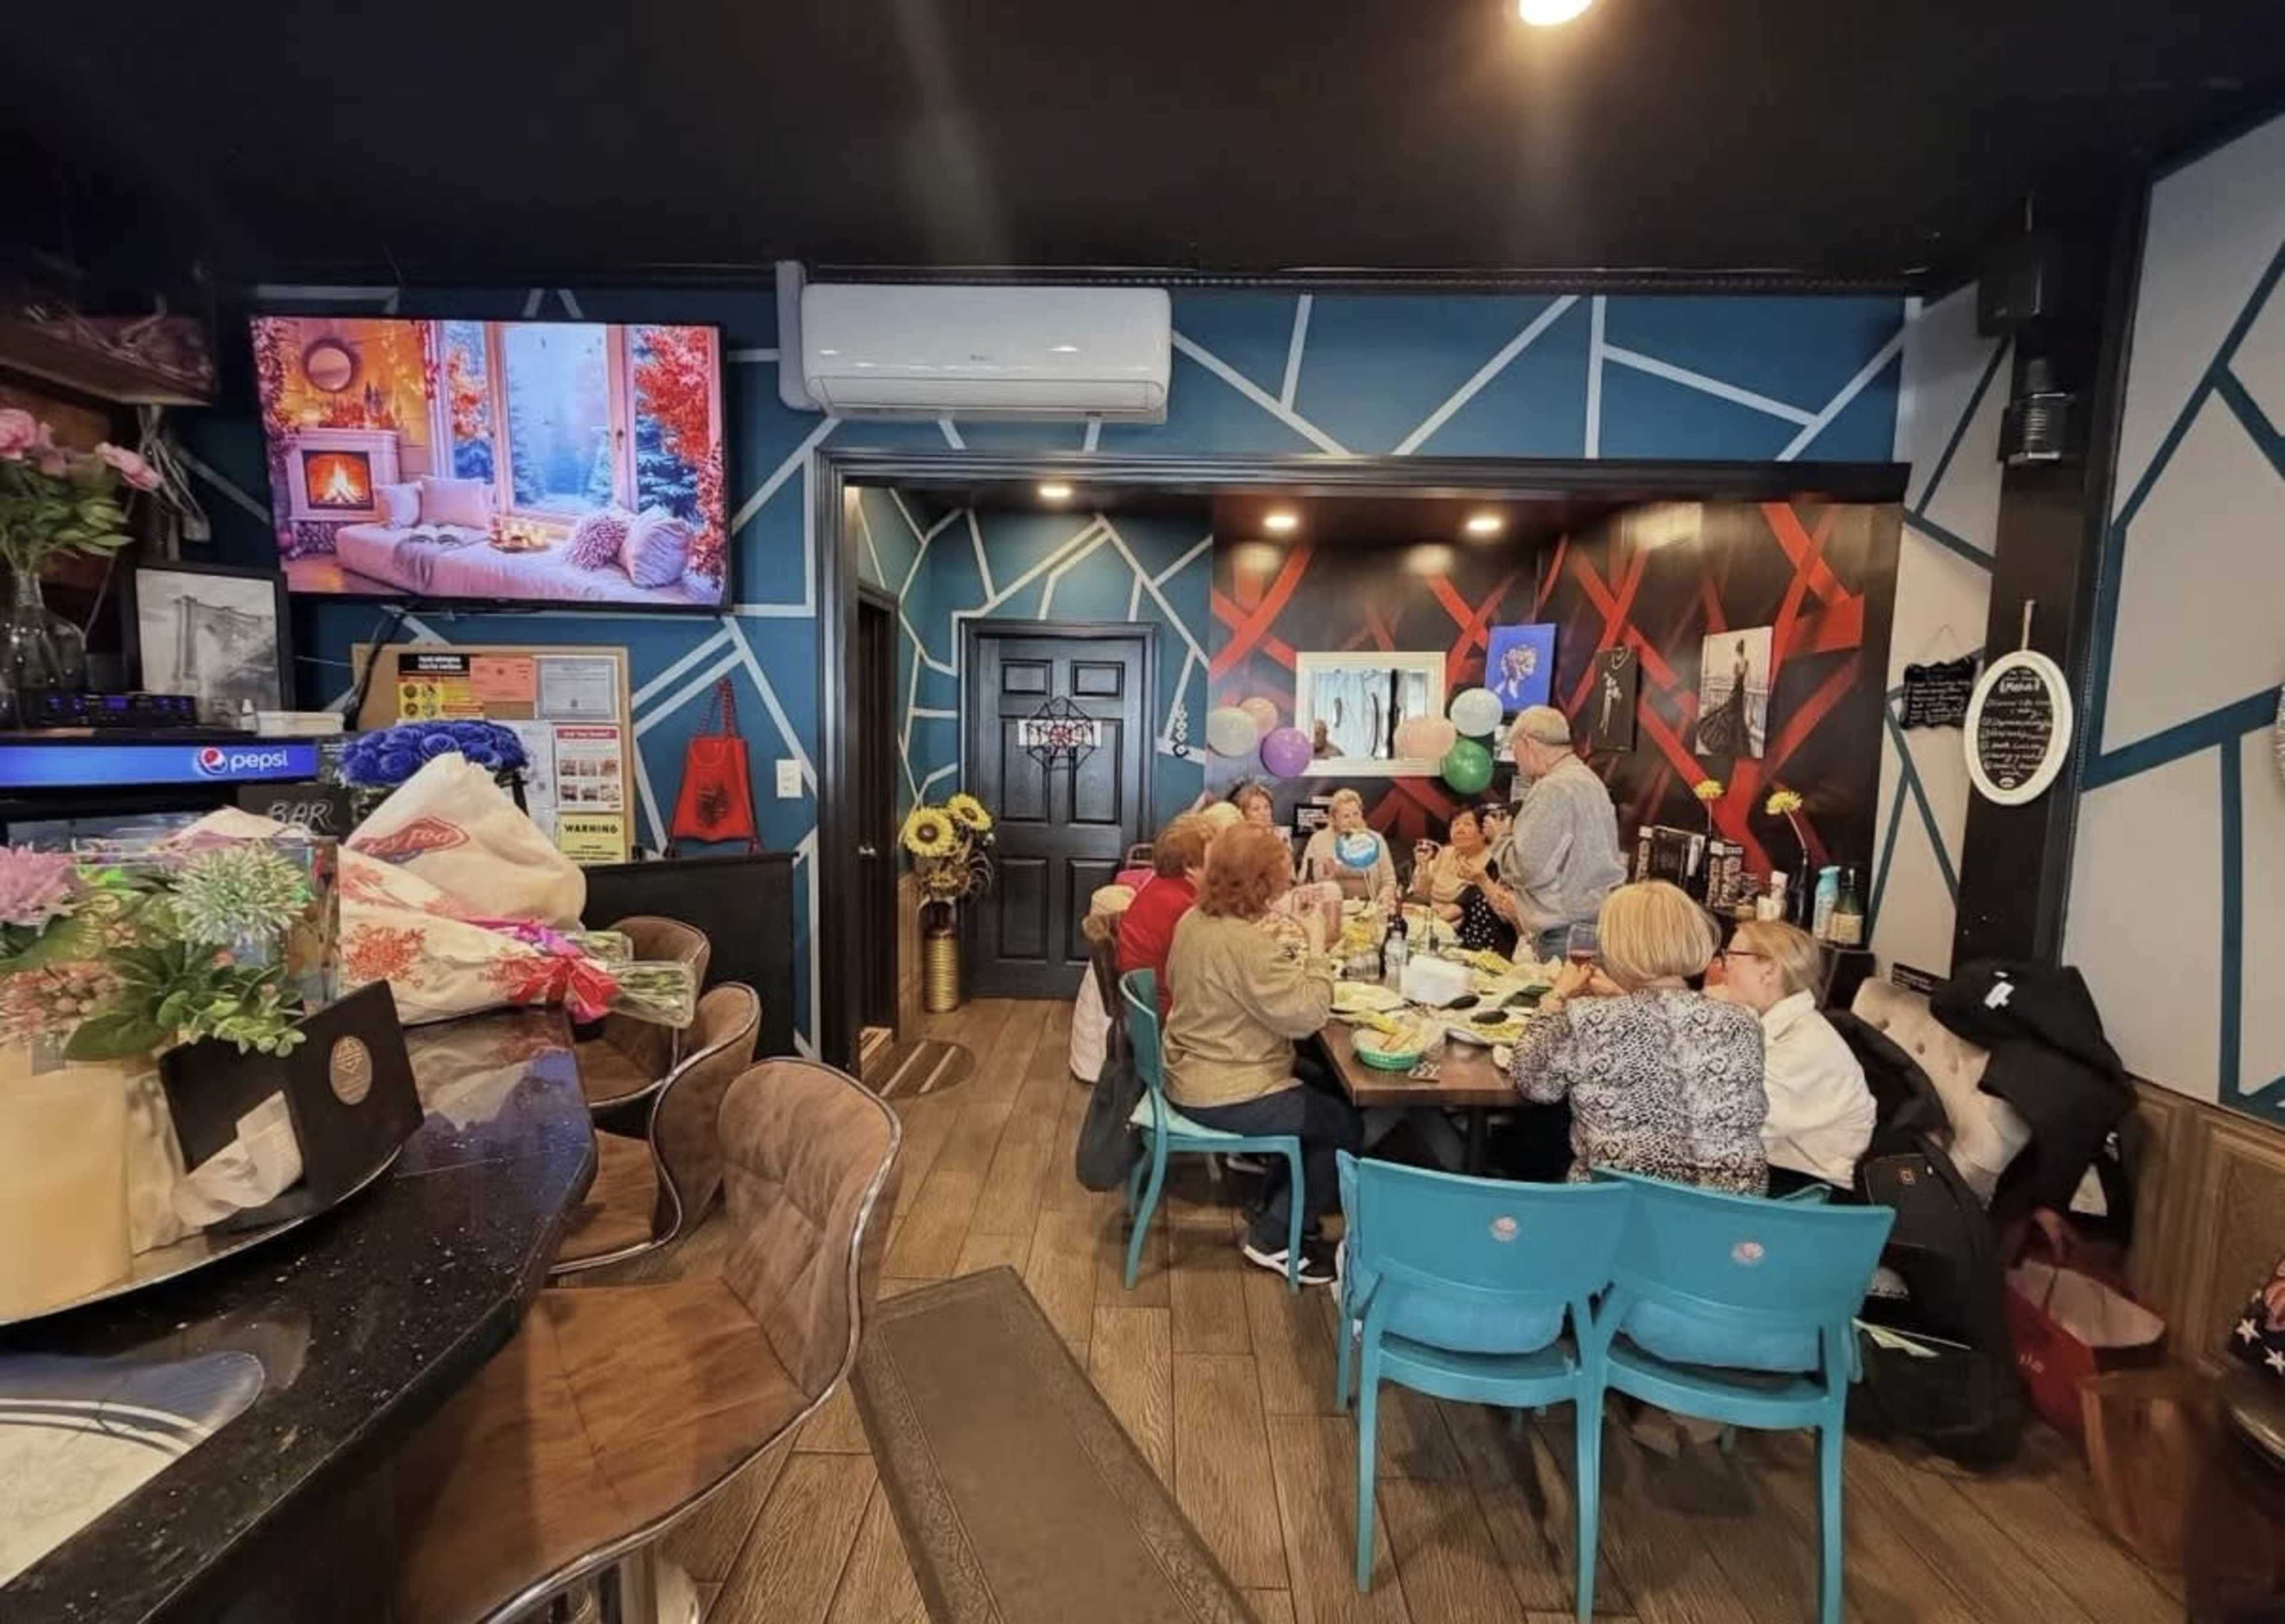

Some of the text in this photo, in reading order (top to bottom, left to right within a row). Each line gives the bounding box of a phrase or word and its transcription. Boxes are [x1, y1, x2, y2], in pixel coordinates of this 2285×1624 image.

[230, 750, 288, 772] pepsi
[270, 799, 333, 830] BAR
[564, 824, 618, 834] WARNING
